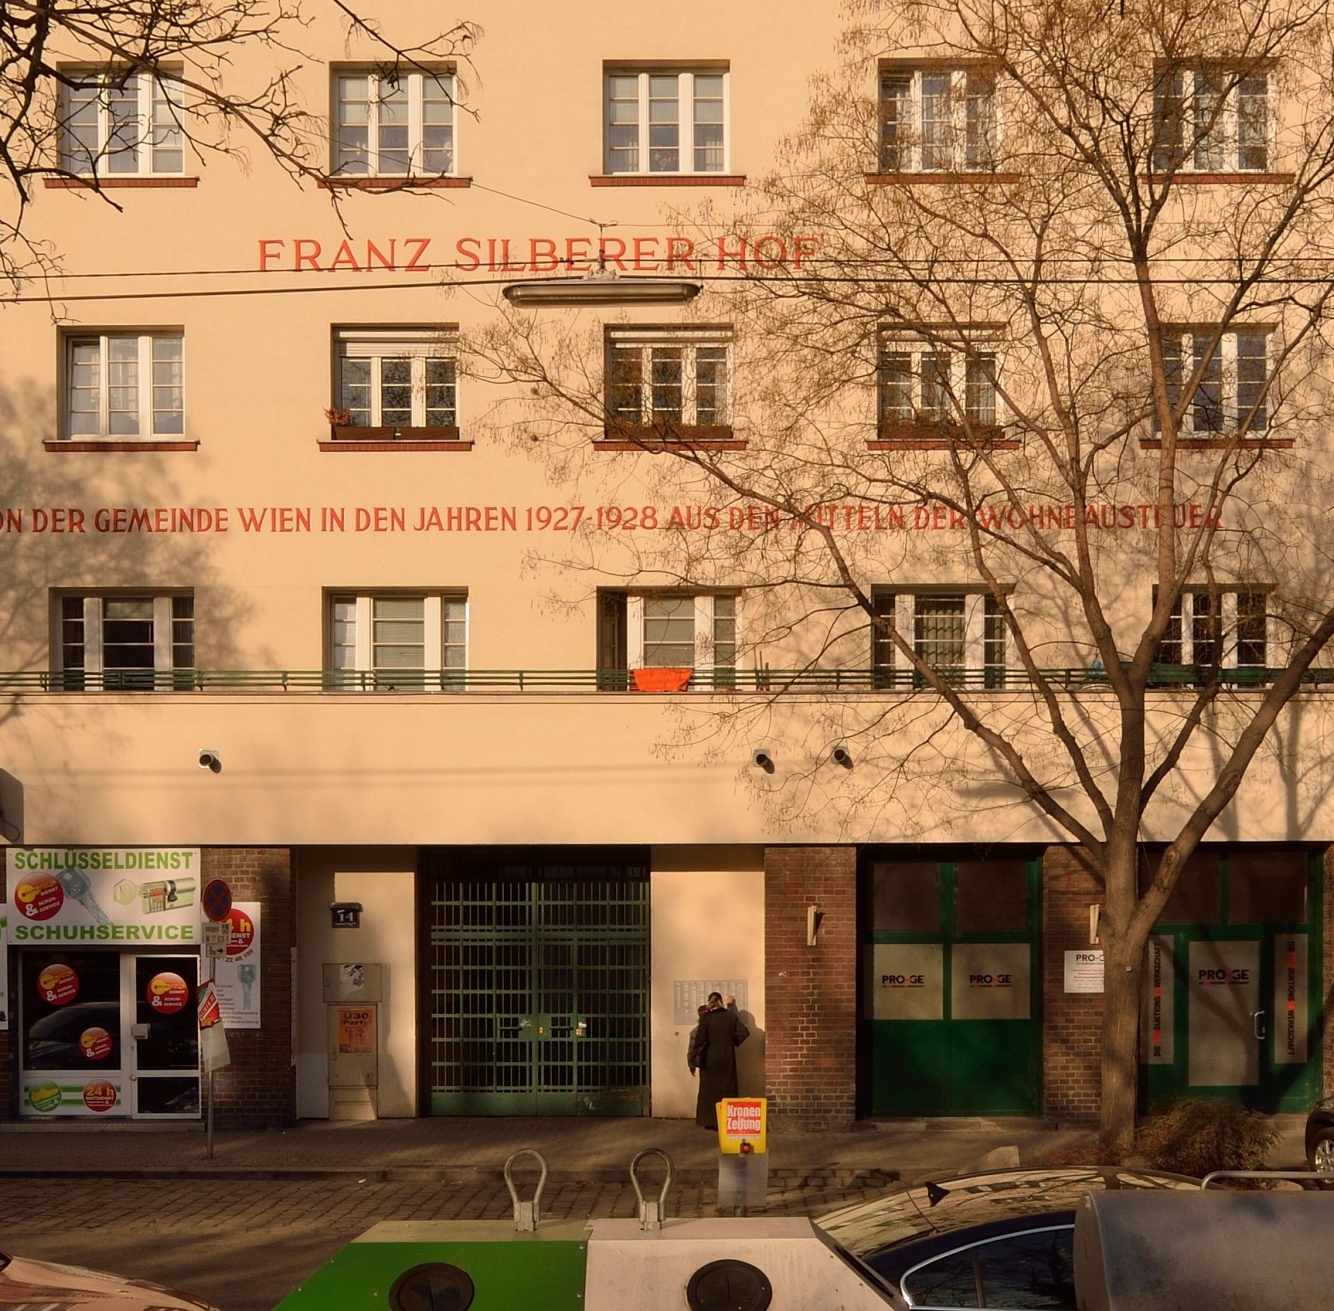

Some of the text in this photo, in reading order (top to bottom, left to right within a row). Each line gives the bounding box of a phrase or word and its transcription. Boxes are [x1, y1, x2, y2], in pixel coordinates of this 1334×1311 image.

[258, 236, 819, 272] FRANZ SILBERER HOF
[32, 508, 86, 533] DER
[94, 508, 229, 532] GEMEINDE
[236, 507, 311, 532] WIEN
[321, 507, 346, 531] IN
[354, 507, 405, 531] DEN
[413, 506, 517, 531] JAHREN
[667, 505, 720, 531] AUS
[729, 505, 781, 530] DEN
[913, 505, 967, 530] DER
[15, 848, 193, 870] SCHLÜSSELDIENST
[15, 925, 194, 940] SCHUHSERVICE
[727, 1104, 761, 1117] Kronen
[727, 1117, 761, 1132] Zeitung
